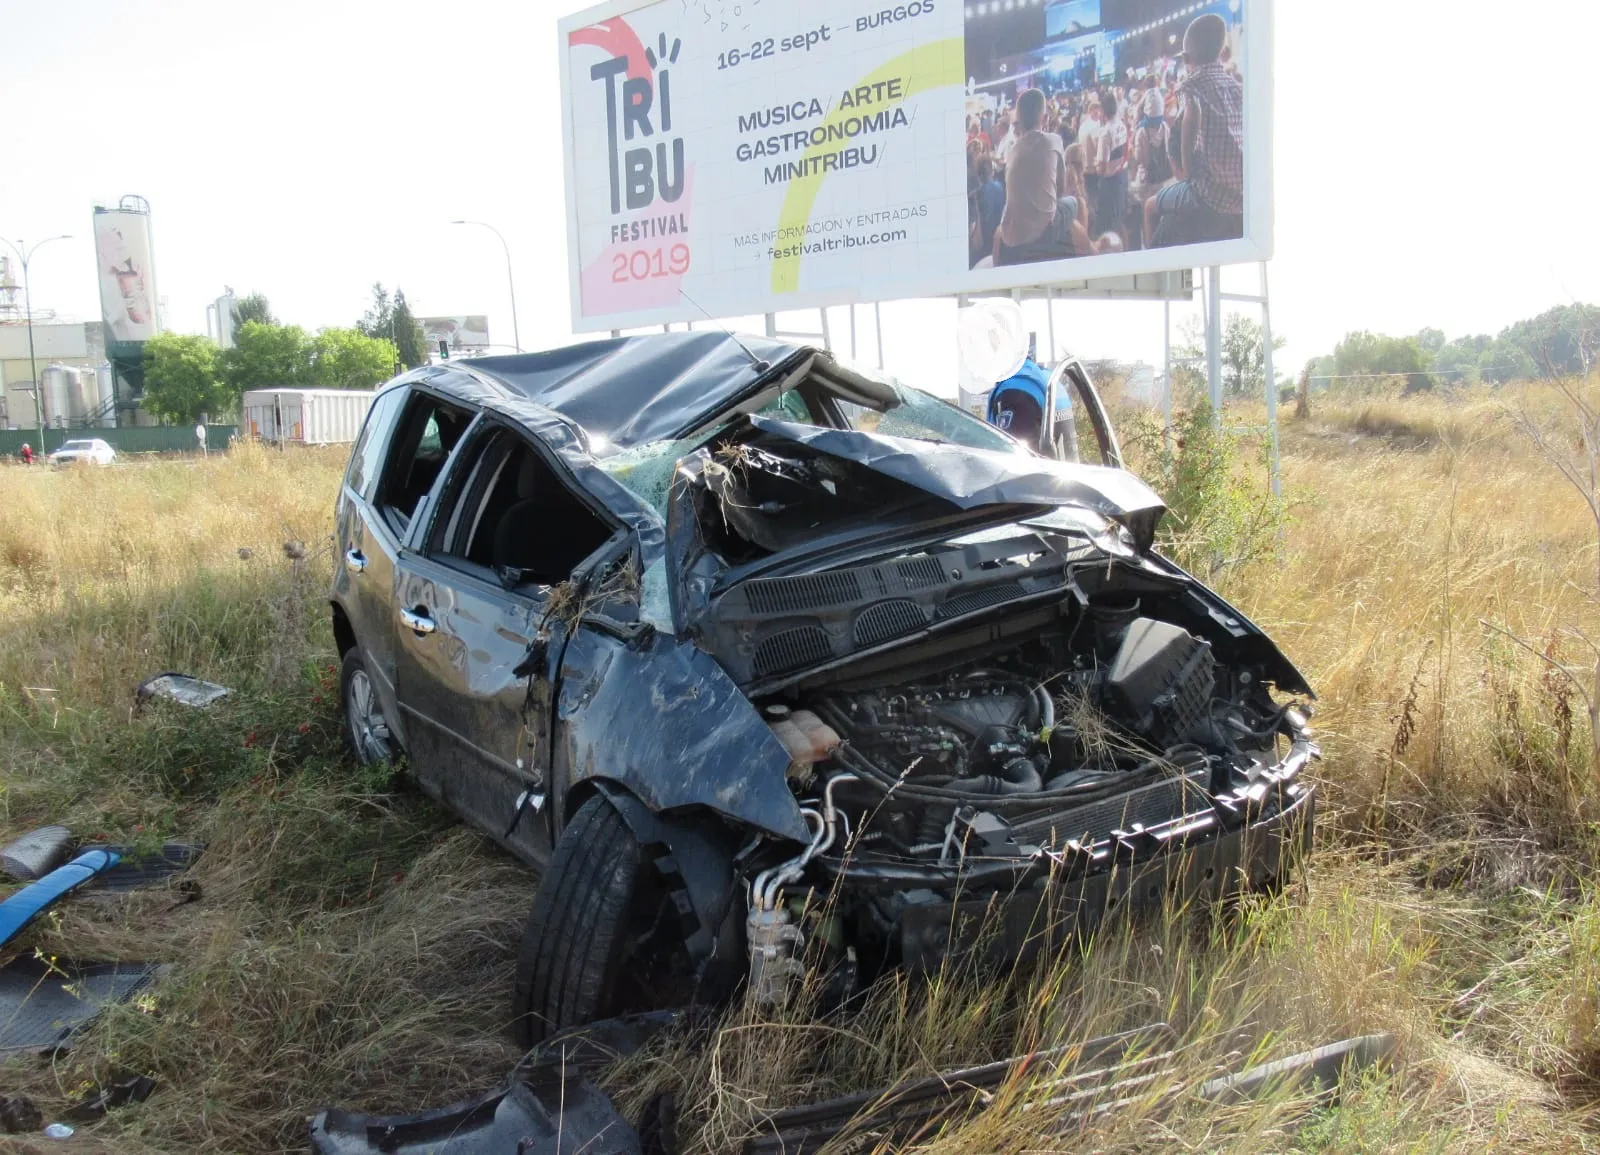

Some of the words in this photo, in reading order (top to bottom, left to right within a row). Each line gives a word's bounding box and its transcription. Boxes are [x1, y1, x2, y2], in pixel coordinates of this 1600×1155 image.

[716, 38, 775, 70] 16-22
[780, 24, 831, 51] sept
[855, 0, 936, 32] BURGOS
[611, 213, 689, 244] FESTIVAL
[846, 217, 853, 229] Y
[856, 205, 928, 227] ENTRADAS
[767, 228, 907, 261] festivaltribu.com
[611, 243, 691, 284] 2019
